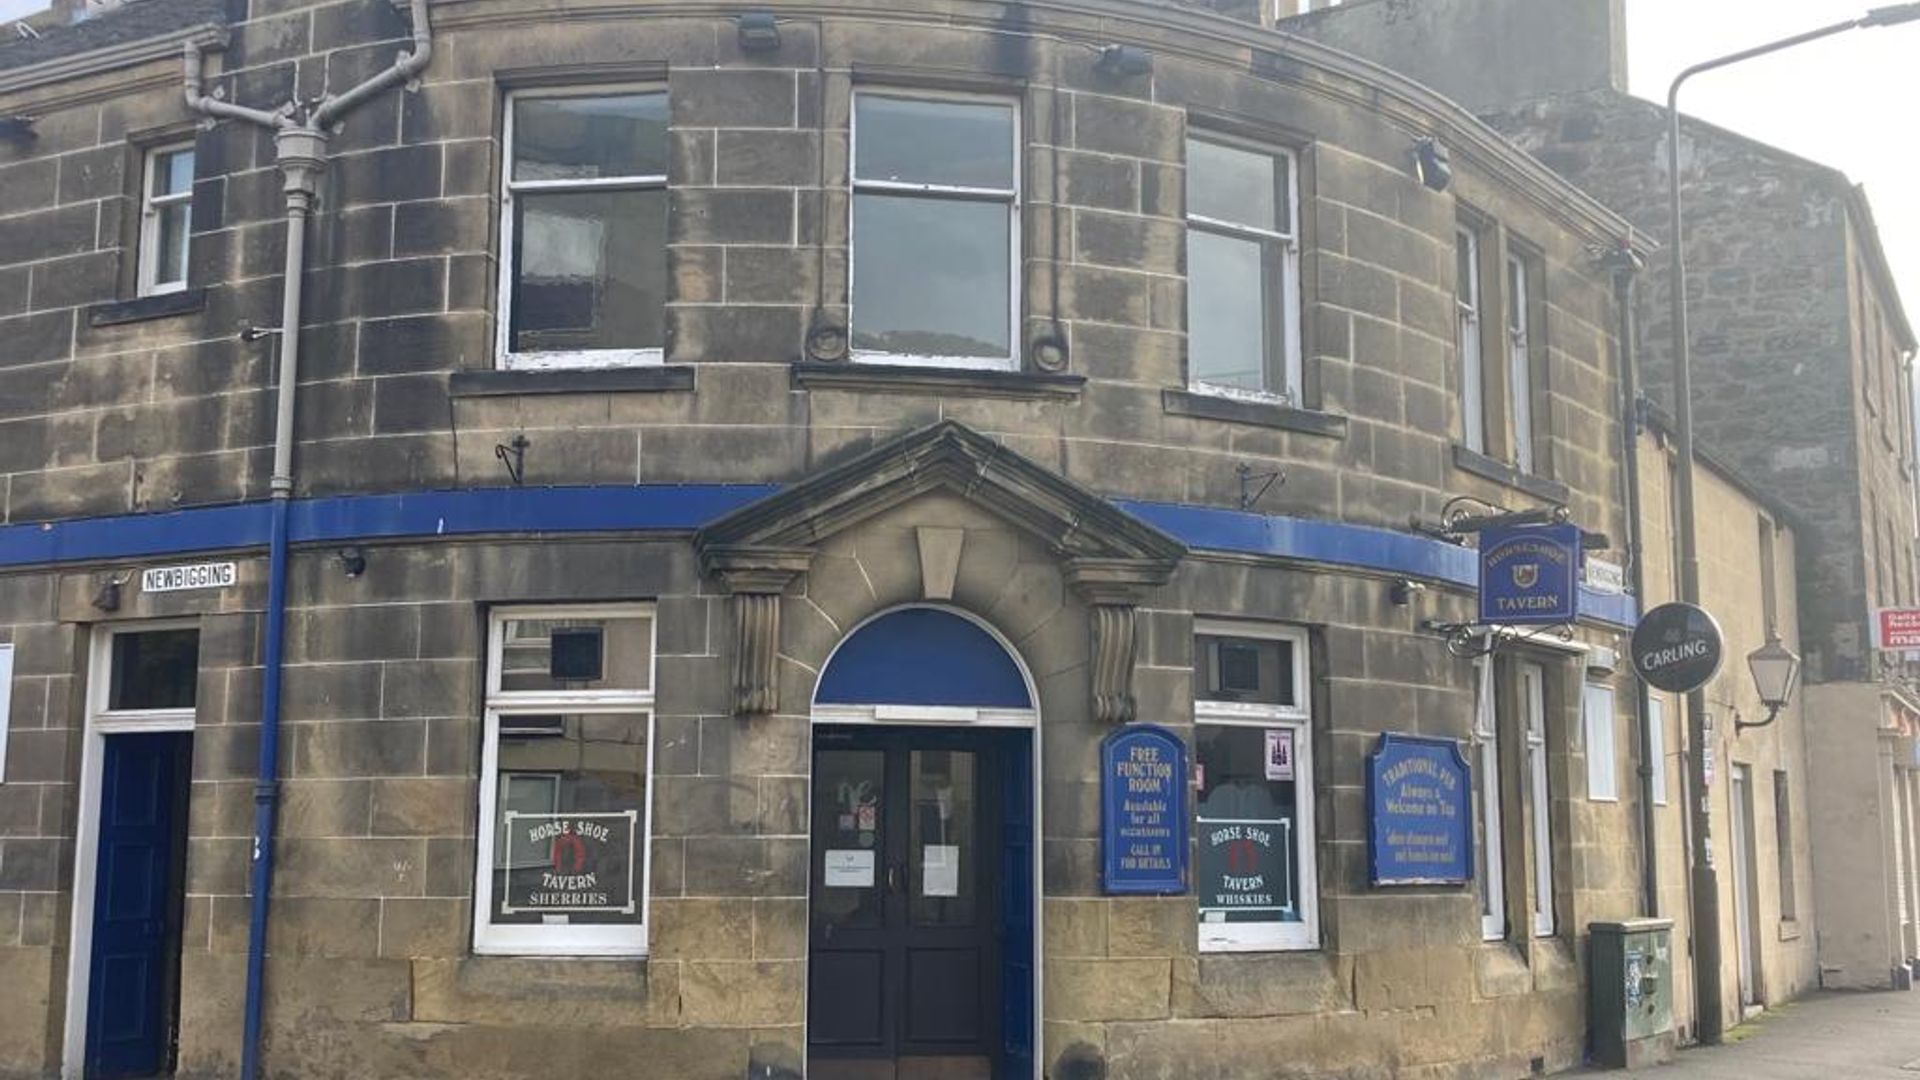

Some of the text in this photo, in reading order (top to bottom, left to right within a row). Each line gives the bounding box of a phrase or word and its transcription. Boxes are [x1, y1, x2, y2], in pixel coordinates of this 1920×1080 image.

[145, 564, 232, 590] NEWBIGGING
[1498, 595, 1559, 611] TAVERN
[1643, 639, 1707, 671] CARLING
[1130, 746, 1160, 761] FREE
[1116, 761, 1172, 777] FUNCTION
[1128, 777, 1162, 792] ROOM
[1384, 797, 1425, 814] Welcome
[528, 821, 609, 842] HORSE SHOE
[1211, 826, 1271, 847] HORSE SHOE
[542, 872, 598, 890] TAVERN
[1222, 874, 1264, 891] TAVERN
[529, 892, 608, 905] SHERRIES
[1216, 894, 1272, 905] WHISKIES
